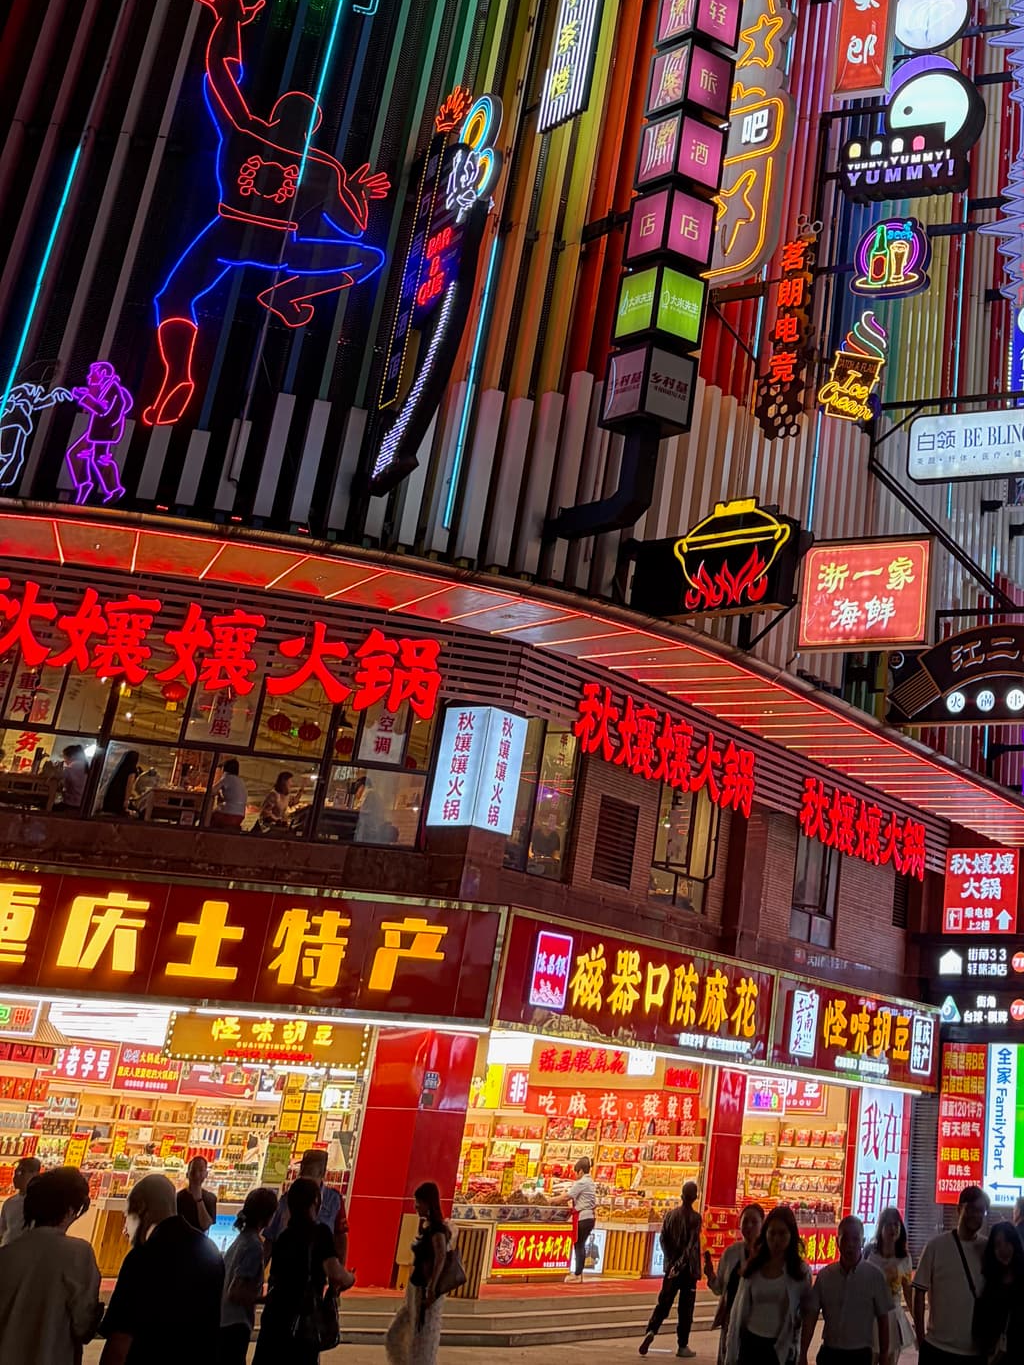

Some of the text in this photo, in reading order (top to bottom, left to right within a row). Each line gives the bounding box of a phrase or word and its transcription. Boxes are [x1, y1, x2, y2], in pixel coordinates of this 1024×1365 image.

[847, 158, 956, 187] YUMMY!
[890, 148, 952, 166] YUMMY!
[817, 380, 874, 420] Cream
[838, 369, 869, 399] Ice
[917, 429, 956, 451] 白领
[963, 426, 984, 448] BE
[816, 556, 917, 595] 浙一家
[830, 596, 897, 631] 海鲜
[441, 710, 476, 822] 秋孃孃火锅
[573, 683, 756, 819] 秋孃孃火锅
[486, 716, 515, 828] 秋孃孃火锅
[800, 776, 926, 883] 秋孃孃火锅
[950, 852, 1016, 876] 秋孃孃
[960, 876, 1003, 900] 火锅
[568, 942, 759, 1038] 磁器口陈麻花
[211, 1016, 334, 1047] 怪味胡豆
[823, 998, 911, 1061] 怪味胡豆
[991, 1046, 1013, 1171] 全家 FamilyMart
[861, 1099, 901, 1163] 我在
[941, 1121, 981, 1138] 有天燃气
[940, 1146, 981, 1163] 招租电话
